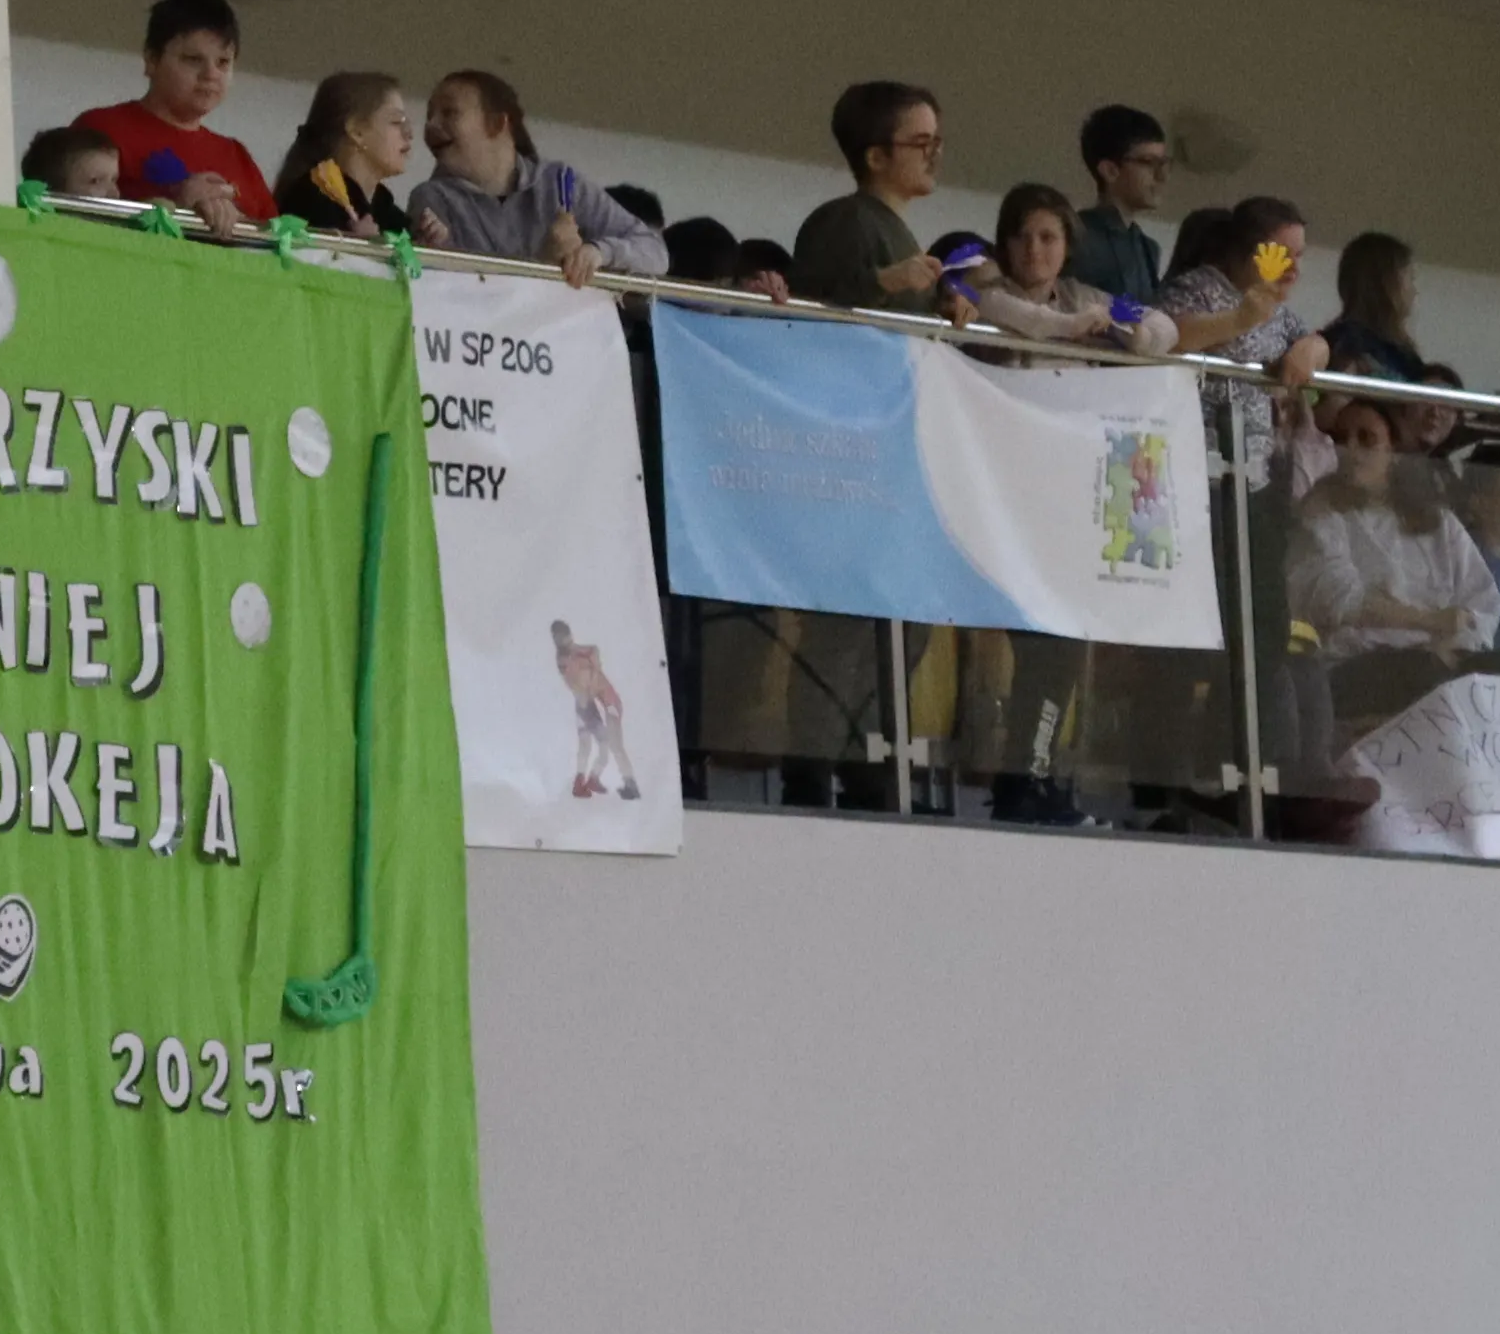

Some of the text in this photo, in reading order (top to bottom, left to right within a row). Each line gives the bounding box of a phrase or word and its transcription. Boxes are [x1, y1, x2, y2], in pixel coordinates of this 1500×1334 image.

[424, 327, 553, 375] W SP 206
